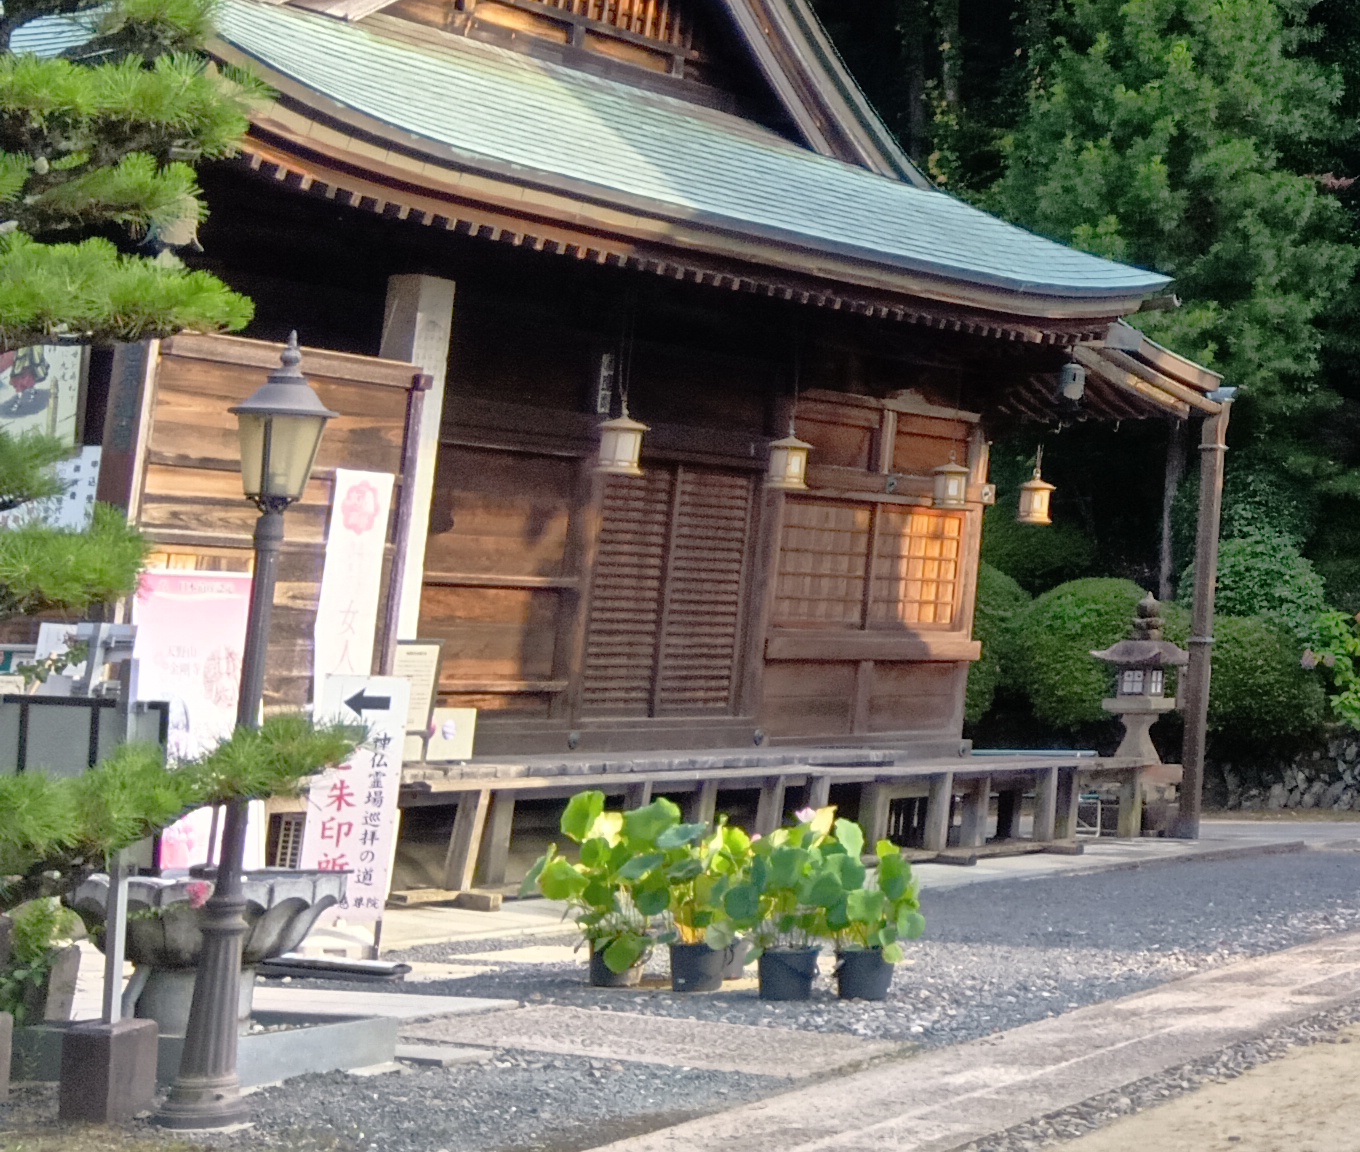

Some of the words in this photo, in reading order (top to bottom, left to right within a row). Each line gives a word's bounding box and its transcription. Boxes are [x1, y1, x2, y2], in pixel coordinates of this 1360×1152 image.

[354, 732, 392, 887] 神仏霊場巡拝の道
